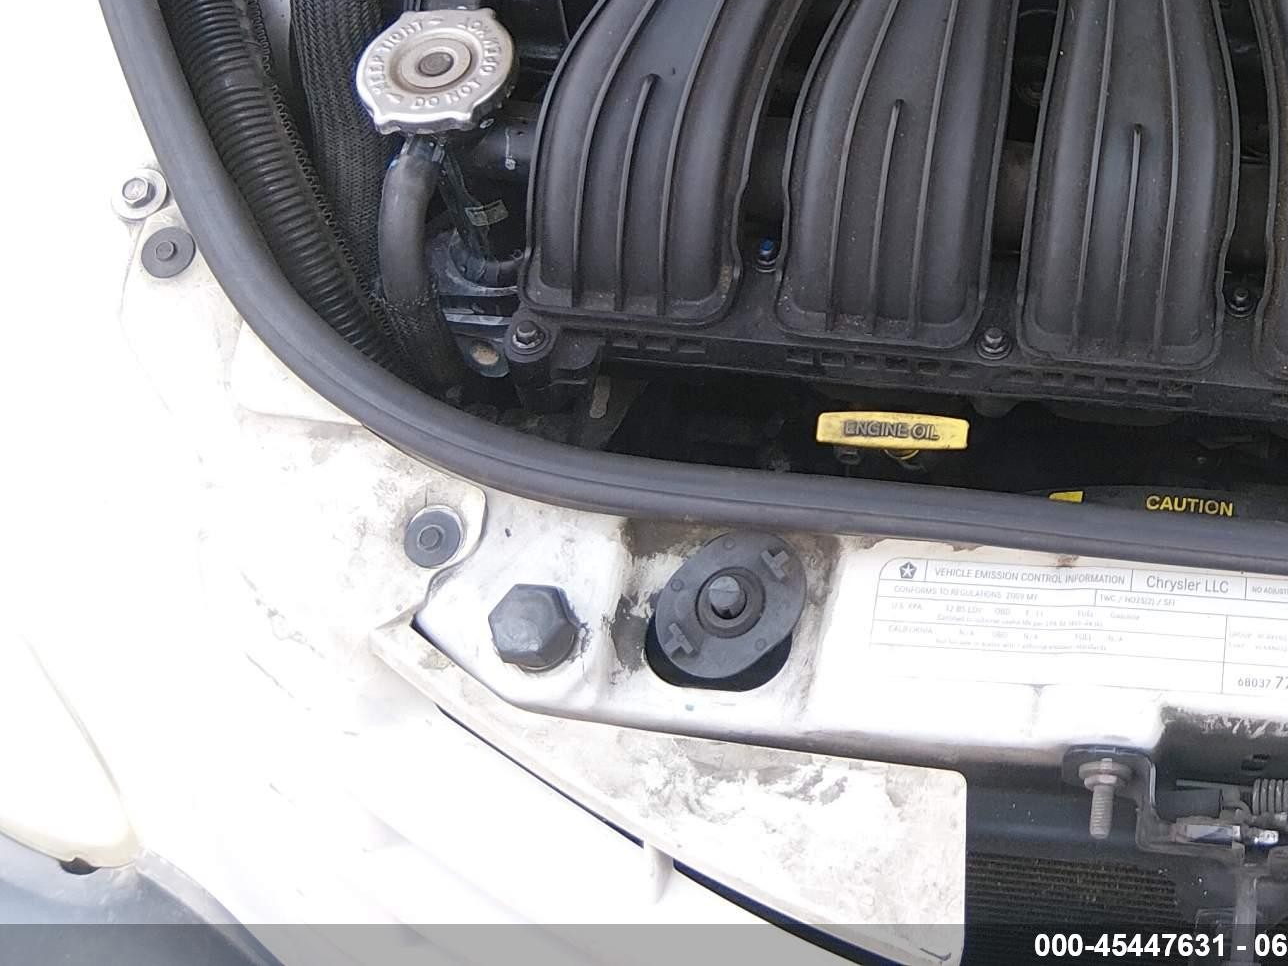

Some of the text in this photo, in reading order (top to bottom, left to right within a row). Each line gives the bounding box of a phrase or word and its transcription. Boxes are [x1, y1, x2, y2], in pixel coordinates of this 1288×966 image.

[410, 95, 440, 111] DO
[444, 80, 482, 104] NOT
[842, 419, 940, 441] ENGINE OIL
[1145, 494, 1235, 517] CAUTION
[935, 567, 1126, 586] VEHICLE EMISSION CONTROL INFORMATION
[1146, 575, 1230, 594] Chrysler LLC
[894, 585, 937, 596] CONFORMS
[940, 587, 949, 596] TO
[1100, 594, 1116, 603] TWC
[1252, 585, 1262, 594] NO
[1237, 677, 1271, 689] 68037
